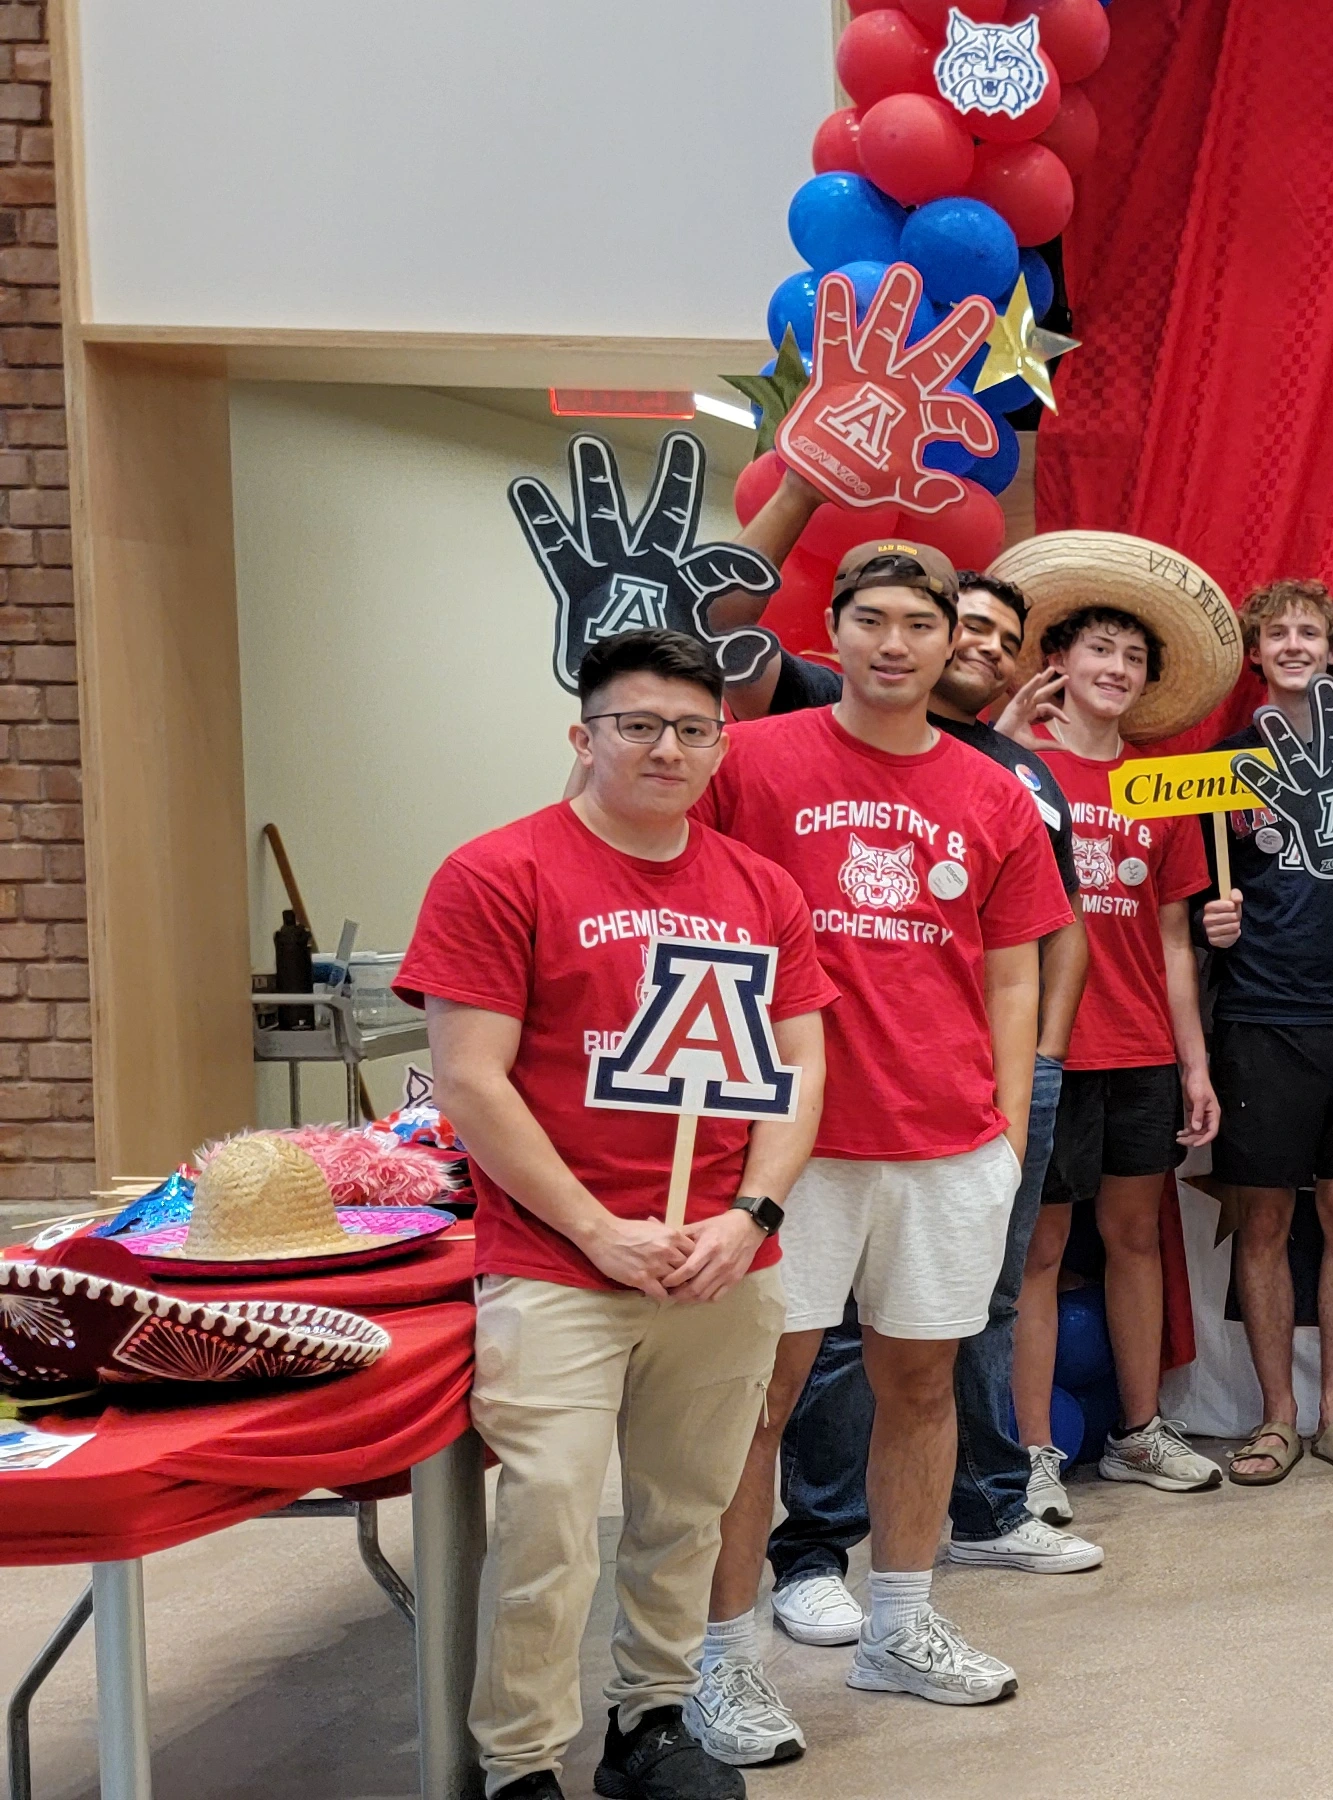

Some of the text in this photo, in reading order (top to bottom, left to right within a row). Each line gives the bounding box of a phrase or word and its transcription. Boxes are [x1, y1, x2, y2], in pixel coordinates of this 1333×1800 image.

[814, 381, 907, 470] A
[1124, 772, 1253, 805] Chemi
[794, 800, 968, 862] CHEMISTRY &
[1068, 802, 1135, 836] MISTRY
[1137, 824, 1152, 849] &
[579, 908, 728, 949] CHEMISTRY
[812, 908, 953, 947] OCHEMISTRY
[594, 942, 795, 1115] A
